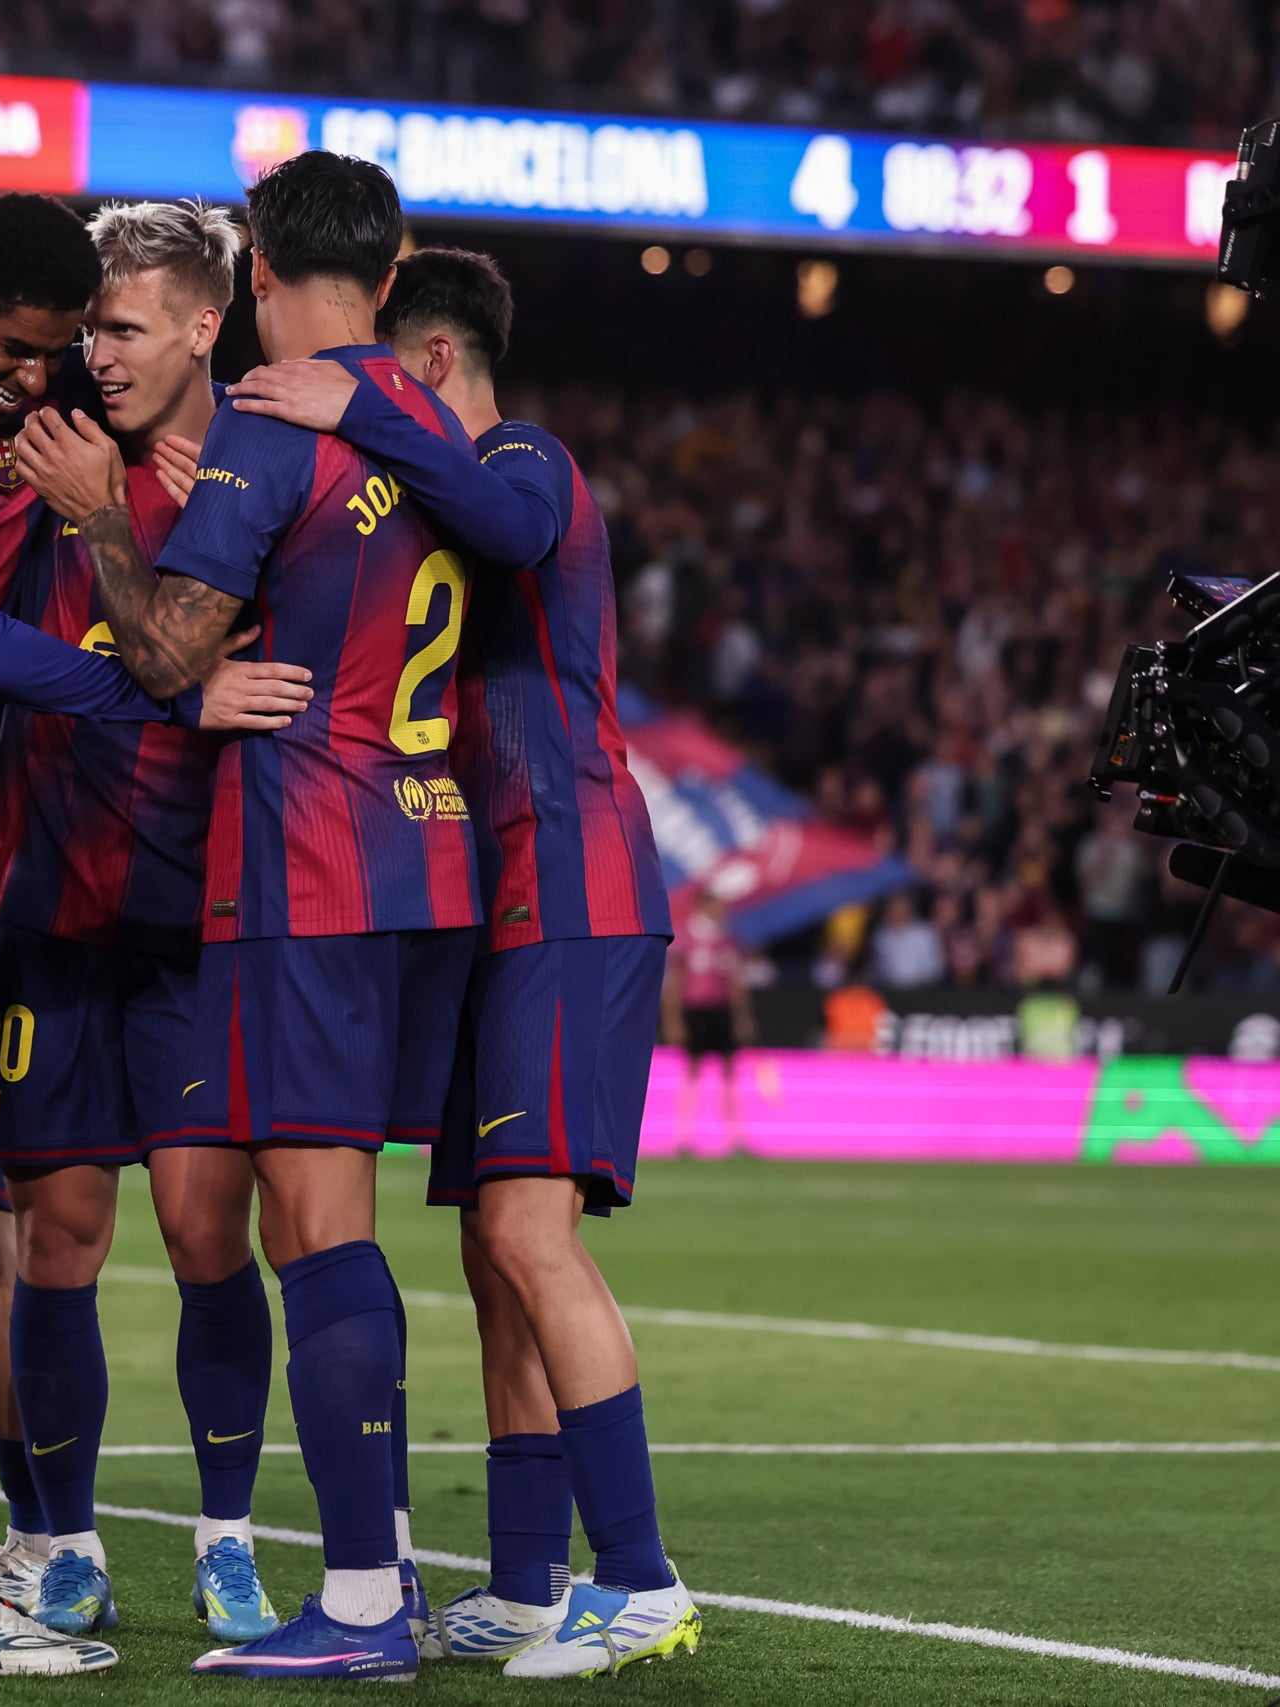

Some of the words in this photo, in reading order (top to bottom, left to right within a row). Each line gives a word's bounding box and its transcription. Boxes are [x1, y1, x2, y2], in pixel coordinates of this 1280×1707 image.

[397, 111, 708, 219] BARCELONA
[790, 133, 858, 231] 4
[1066, 150, 1118, 246] 1
[235, 477, 250, 490] tv
[345, 471, 406, 536] JOA
[388, 549, 466, 755] 2
[435, 794, 468, 813] ACNUR
[362, 1420, 392, 1435] BAR
